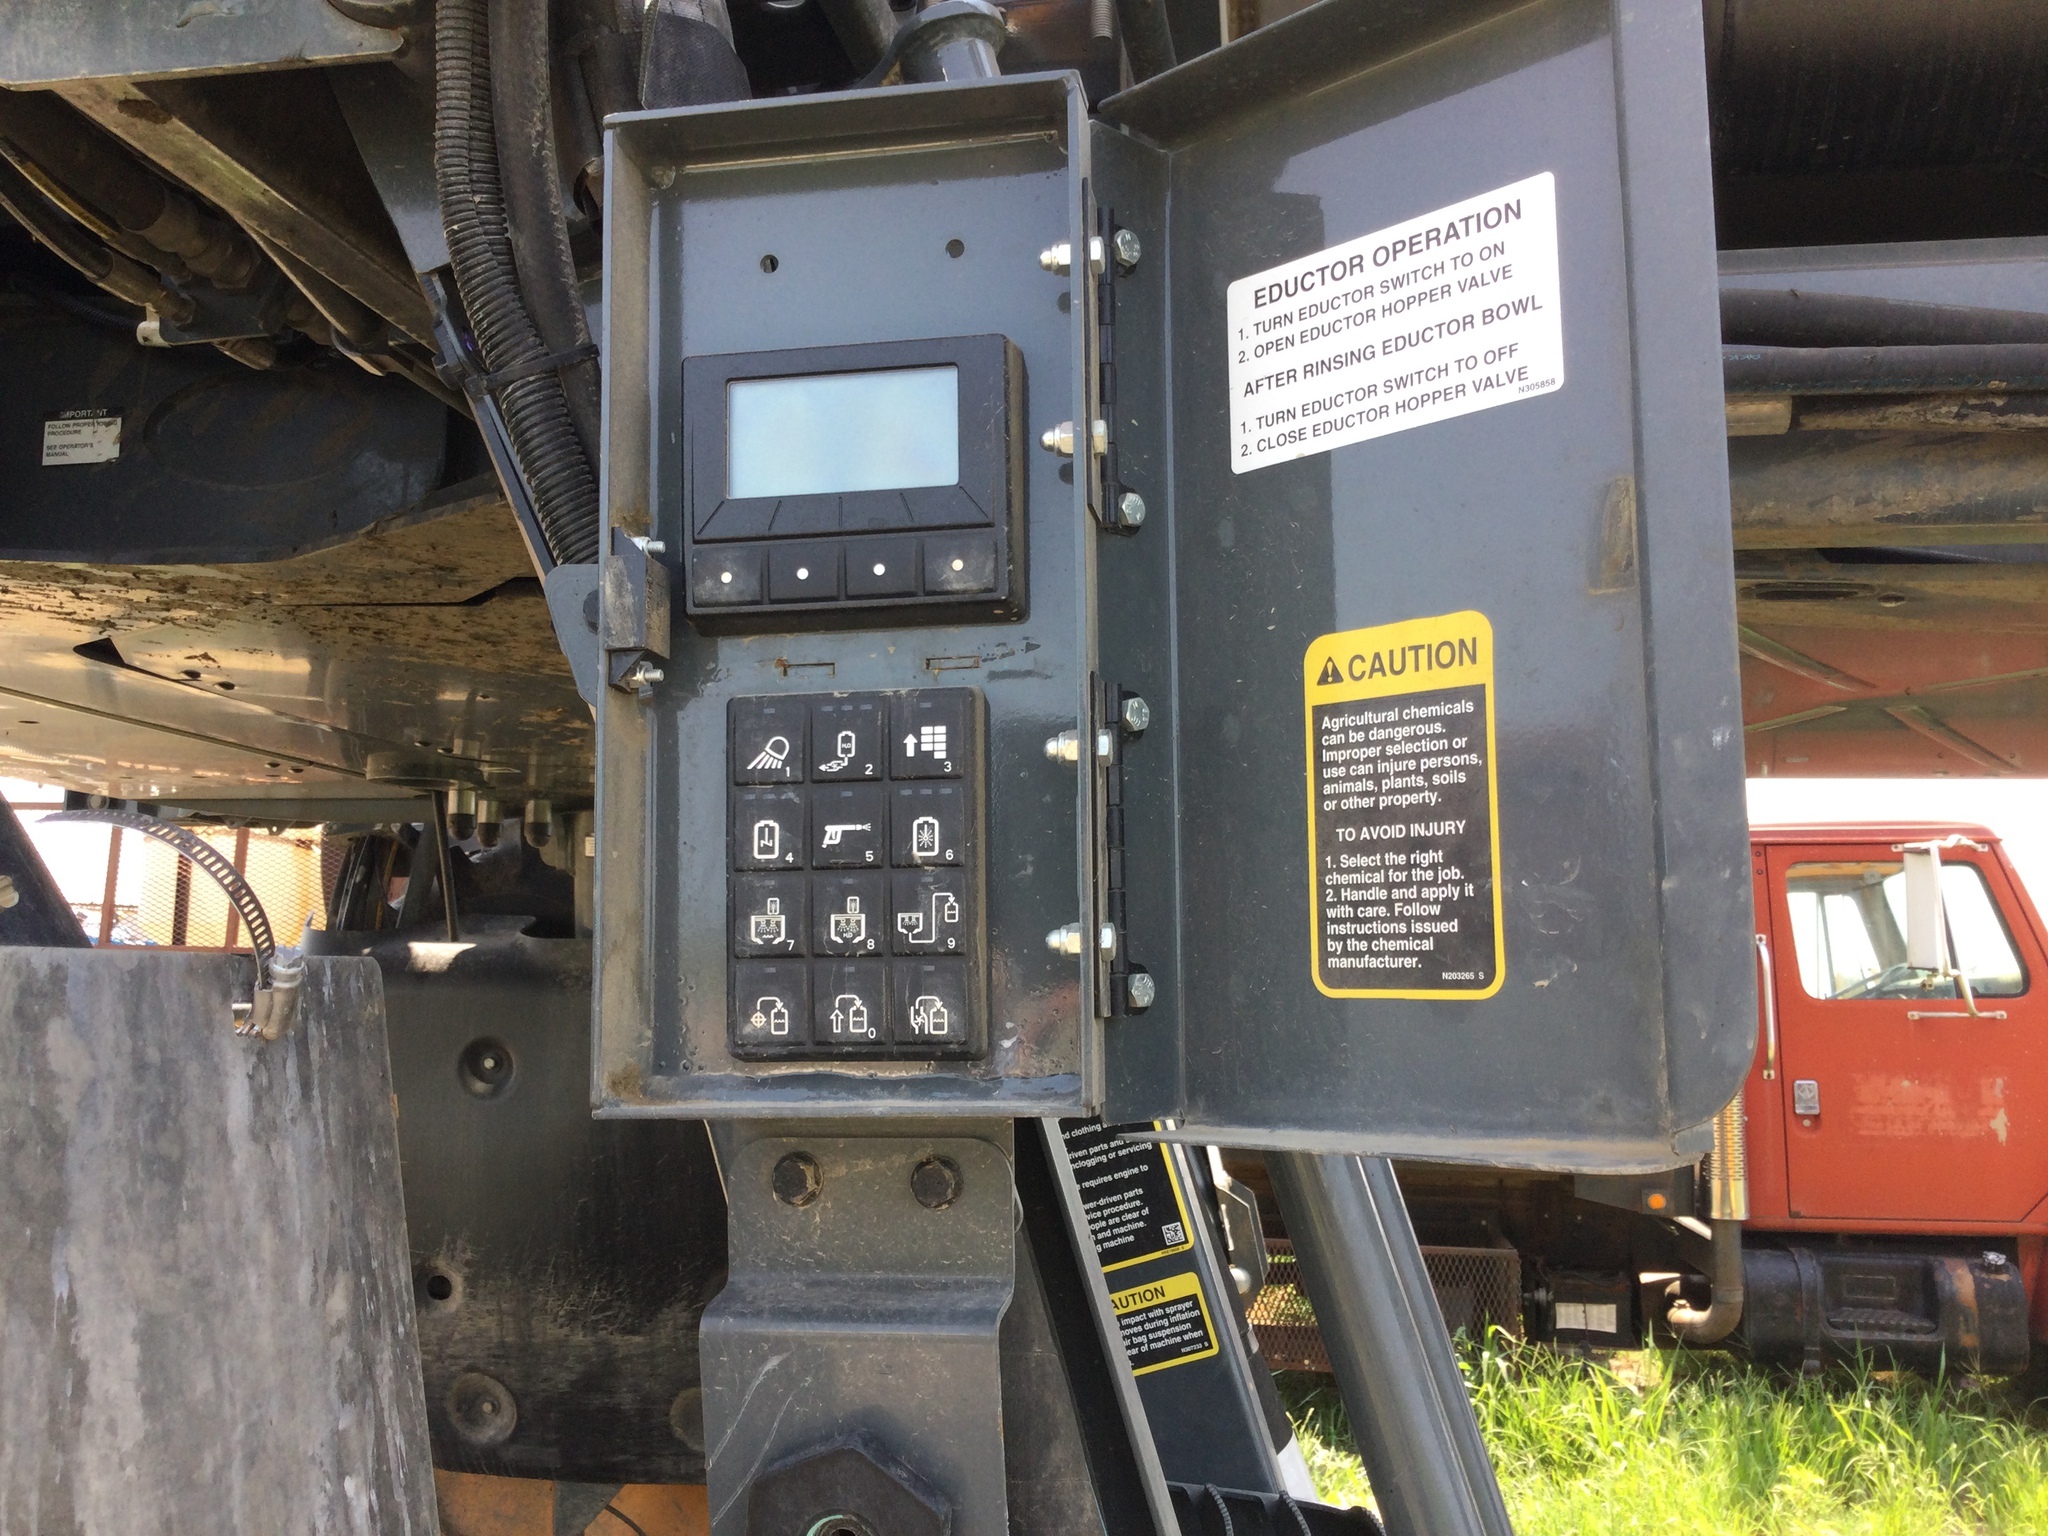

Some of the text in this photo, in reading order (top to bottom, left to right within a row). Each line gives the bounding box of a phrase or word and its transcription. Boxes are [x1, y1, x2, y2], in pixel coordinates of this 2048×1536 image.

[1254, 199, 1522, 308] EDUCTOR OPERATION
[1238, 242, 1505, 341] 1. TURN EDUCTOR SWITCH TO ON
[1238, 265, 1513, 364] 2. OPEN EDUCTOR HOPPER VALVE
[1243, 295, 1543, 397] AFTER RINSING EDUCTOR BOWL
[1241, 343, 1519, 434] 1. TURN EDUCTOR SWITCH TO OFF
[1518, 378, 1556, 394] N305858
[60, 409, 108, 418] IMPORTNT
[1241, 366, 1529, 457] 2. CLOSE EDUCTOR HOPPER VALVE
[1348, 637, 1477, 681] CAUTION
[1322, 700, 1474, 732] Agricultural chemicals
[1322, 723, 1446, 746] can be dangerous.
[1322, 736, 1467, 763] Improper selection or
[785, 762, 952, 778] 1 2 3
[1323, 754, 1482, 780] use can injure persons,
[1323, 771, 1466, 795] animals, plants, soils
[1324, 791, 1442, 811] or other property.
[1336, 820, 1466, 841] TO AVOID INJURY
[785, 849, 954, 863] 4 5 6
[1325, 850, 1443, 868] 1. Select the right
[1325, 866, 1464, 885] chemical for the job.
[1326, 883, 1474, 902] 2. Handle and apply it
[1327, 903, 1440, 918] with care. Follow
[1327, 919, 1458, 935] instructions issued
[787, 938, 956, 950] 7 8 9
[1327, 937, 1433, 954] by the chemical
[1328, 955, 1422, 968] manufacturer.
[1072, 1124, 1101, 1137] clothing
[1069, 1149, 1088, 1159] riven
[1089, 1143, 1108, 1155] parts
[1071, 1155, 1107, 1169] nclogging
[1118, 1141, 1152, 1154] servicing
[1082, 1174, 1112, 1188] requires
[1114, 1168, 1139, 1179] engine
[1140, 1164, 1148, 1172] to
[1084, 1188, 1143, 1210] wer-driven parts
[1103, 1200, 1143, 1217] procedure.
[1121, 1211, 1139, 1221] clear
[1141, 1207, 1149, 1216] of
[1097, 1230, 1111, 1239] and
[1113, 1221, 1147, 1235] machine.
[1103, 1235, 1134, 1249] machine
[1111, 1286, 1165, 1310] AUTION
[1121, 1313, 1147, 1326] impact
[1148, 1308, 1164, 1318] with
[1165, 1301, 1193, 1314] sprayer
[1144, 1318, 1169, 1330] during
[1170, 1310, 1200, 1323] inflation
[1132, 1335, 1147, 1344] bag
[1148, 1323, 1191, 1340] suspension
[1141, 1344, 1149, 1352] of
[1150, 1336, 1181, 1349] machine
[1182, 1330, 1203, 1340] when
